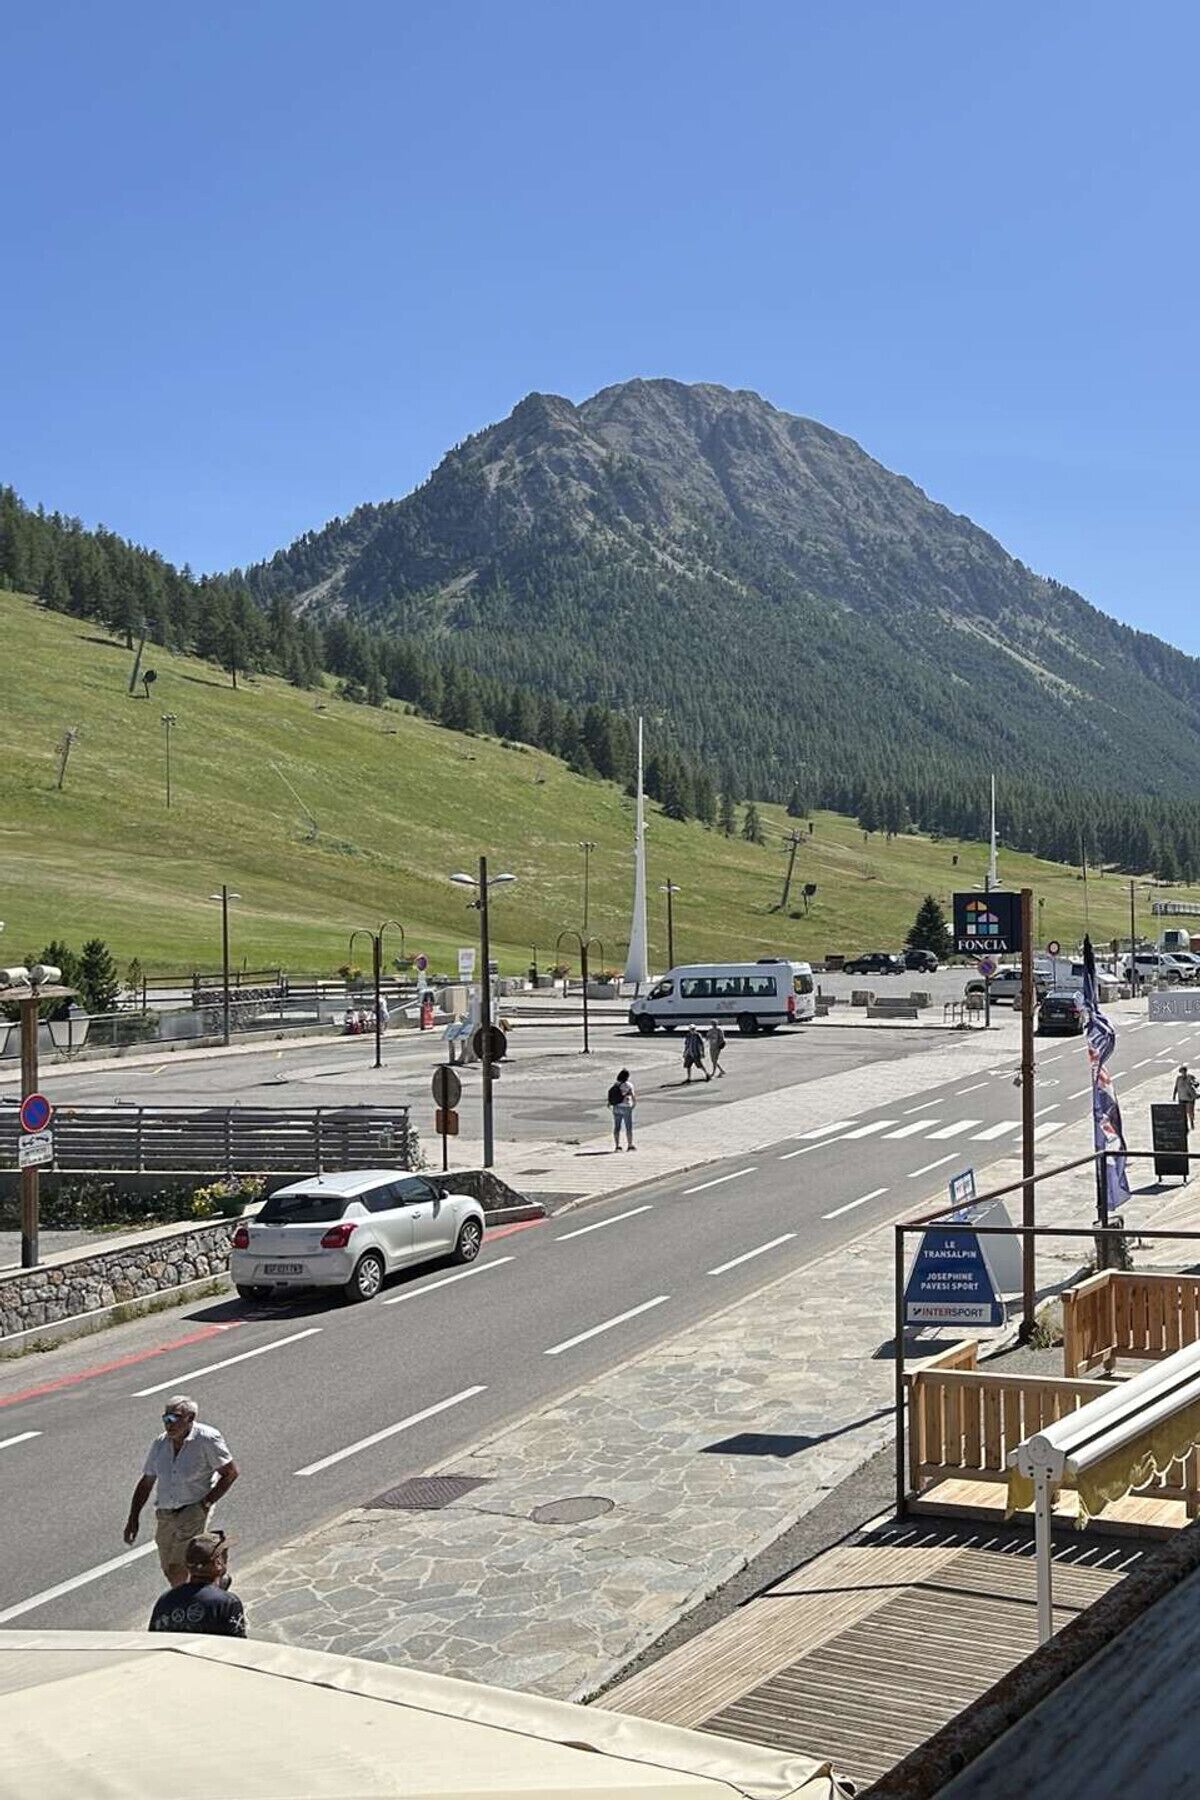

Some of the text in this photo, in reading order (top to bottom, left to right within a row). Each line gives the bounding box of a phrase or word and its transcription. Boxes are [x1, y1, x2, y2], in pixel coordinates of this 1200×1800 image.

[957, 939, 1008, 951] FONCIA
[1152, 999, 1178, 1014] SKI
[944, 1240, 955, 1249] LE
[924, 1250, 977, 1259] TRANSALPIN
[926, 1272, 974, 1281] JOSEPHINE
[920, 1282, 979, 1291] PAVESI SPORT
[922, 1306, 984, 1318] INTERSPORT
